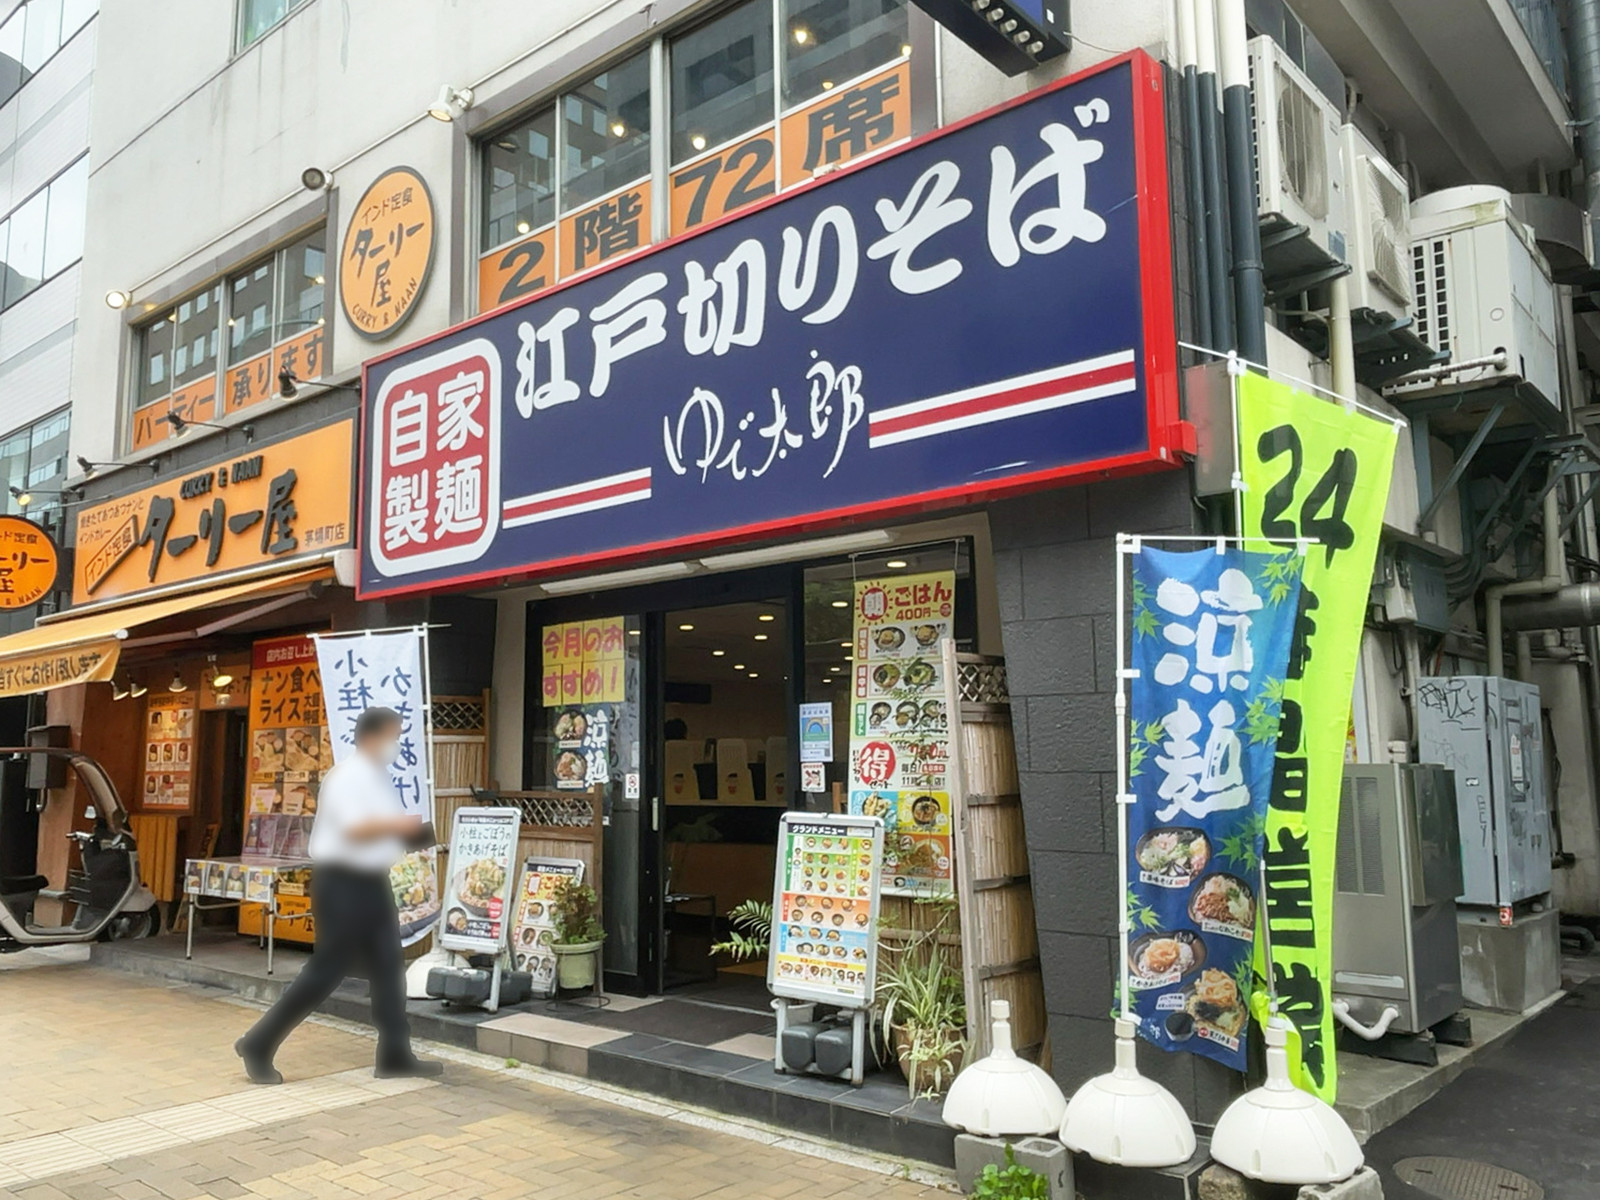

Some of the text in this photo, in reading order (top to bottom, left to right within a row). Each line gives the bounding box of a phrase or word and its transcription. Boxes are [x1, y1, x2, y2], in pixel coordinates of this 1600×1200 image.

[361, 187, 413, 225] インド定食
[349, 222, 425, 279] ターリー
[514, 96, 1111, 419] 江戸切りそば
[352, 303, 379, 329] CURRY
[394, 279, 418, 317] NAAN
[370, 259, 392, 308] 屋
[389, 369, 486, 469] 自家
[662, 349, 865, 485] ゆで太郎
[138, 468, 298, 584] ターリー屋
[385, 454, 484, 551] 製麺
[0, 530, 39, 545] ド定食
[87, 525, 134, 582] インド定食
[894, 581, 953, 607] ごはん
[543, 624, 624, 659] 今月のお
[260, 697, 301, 724] ライス
[1153, 567, 1265, 824] 涼麺
[458, 843, 509, 857] かきあげそば
[792, 825, 845, 834] グランドメニュー
